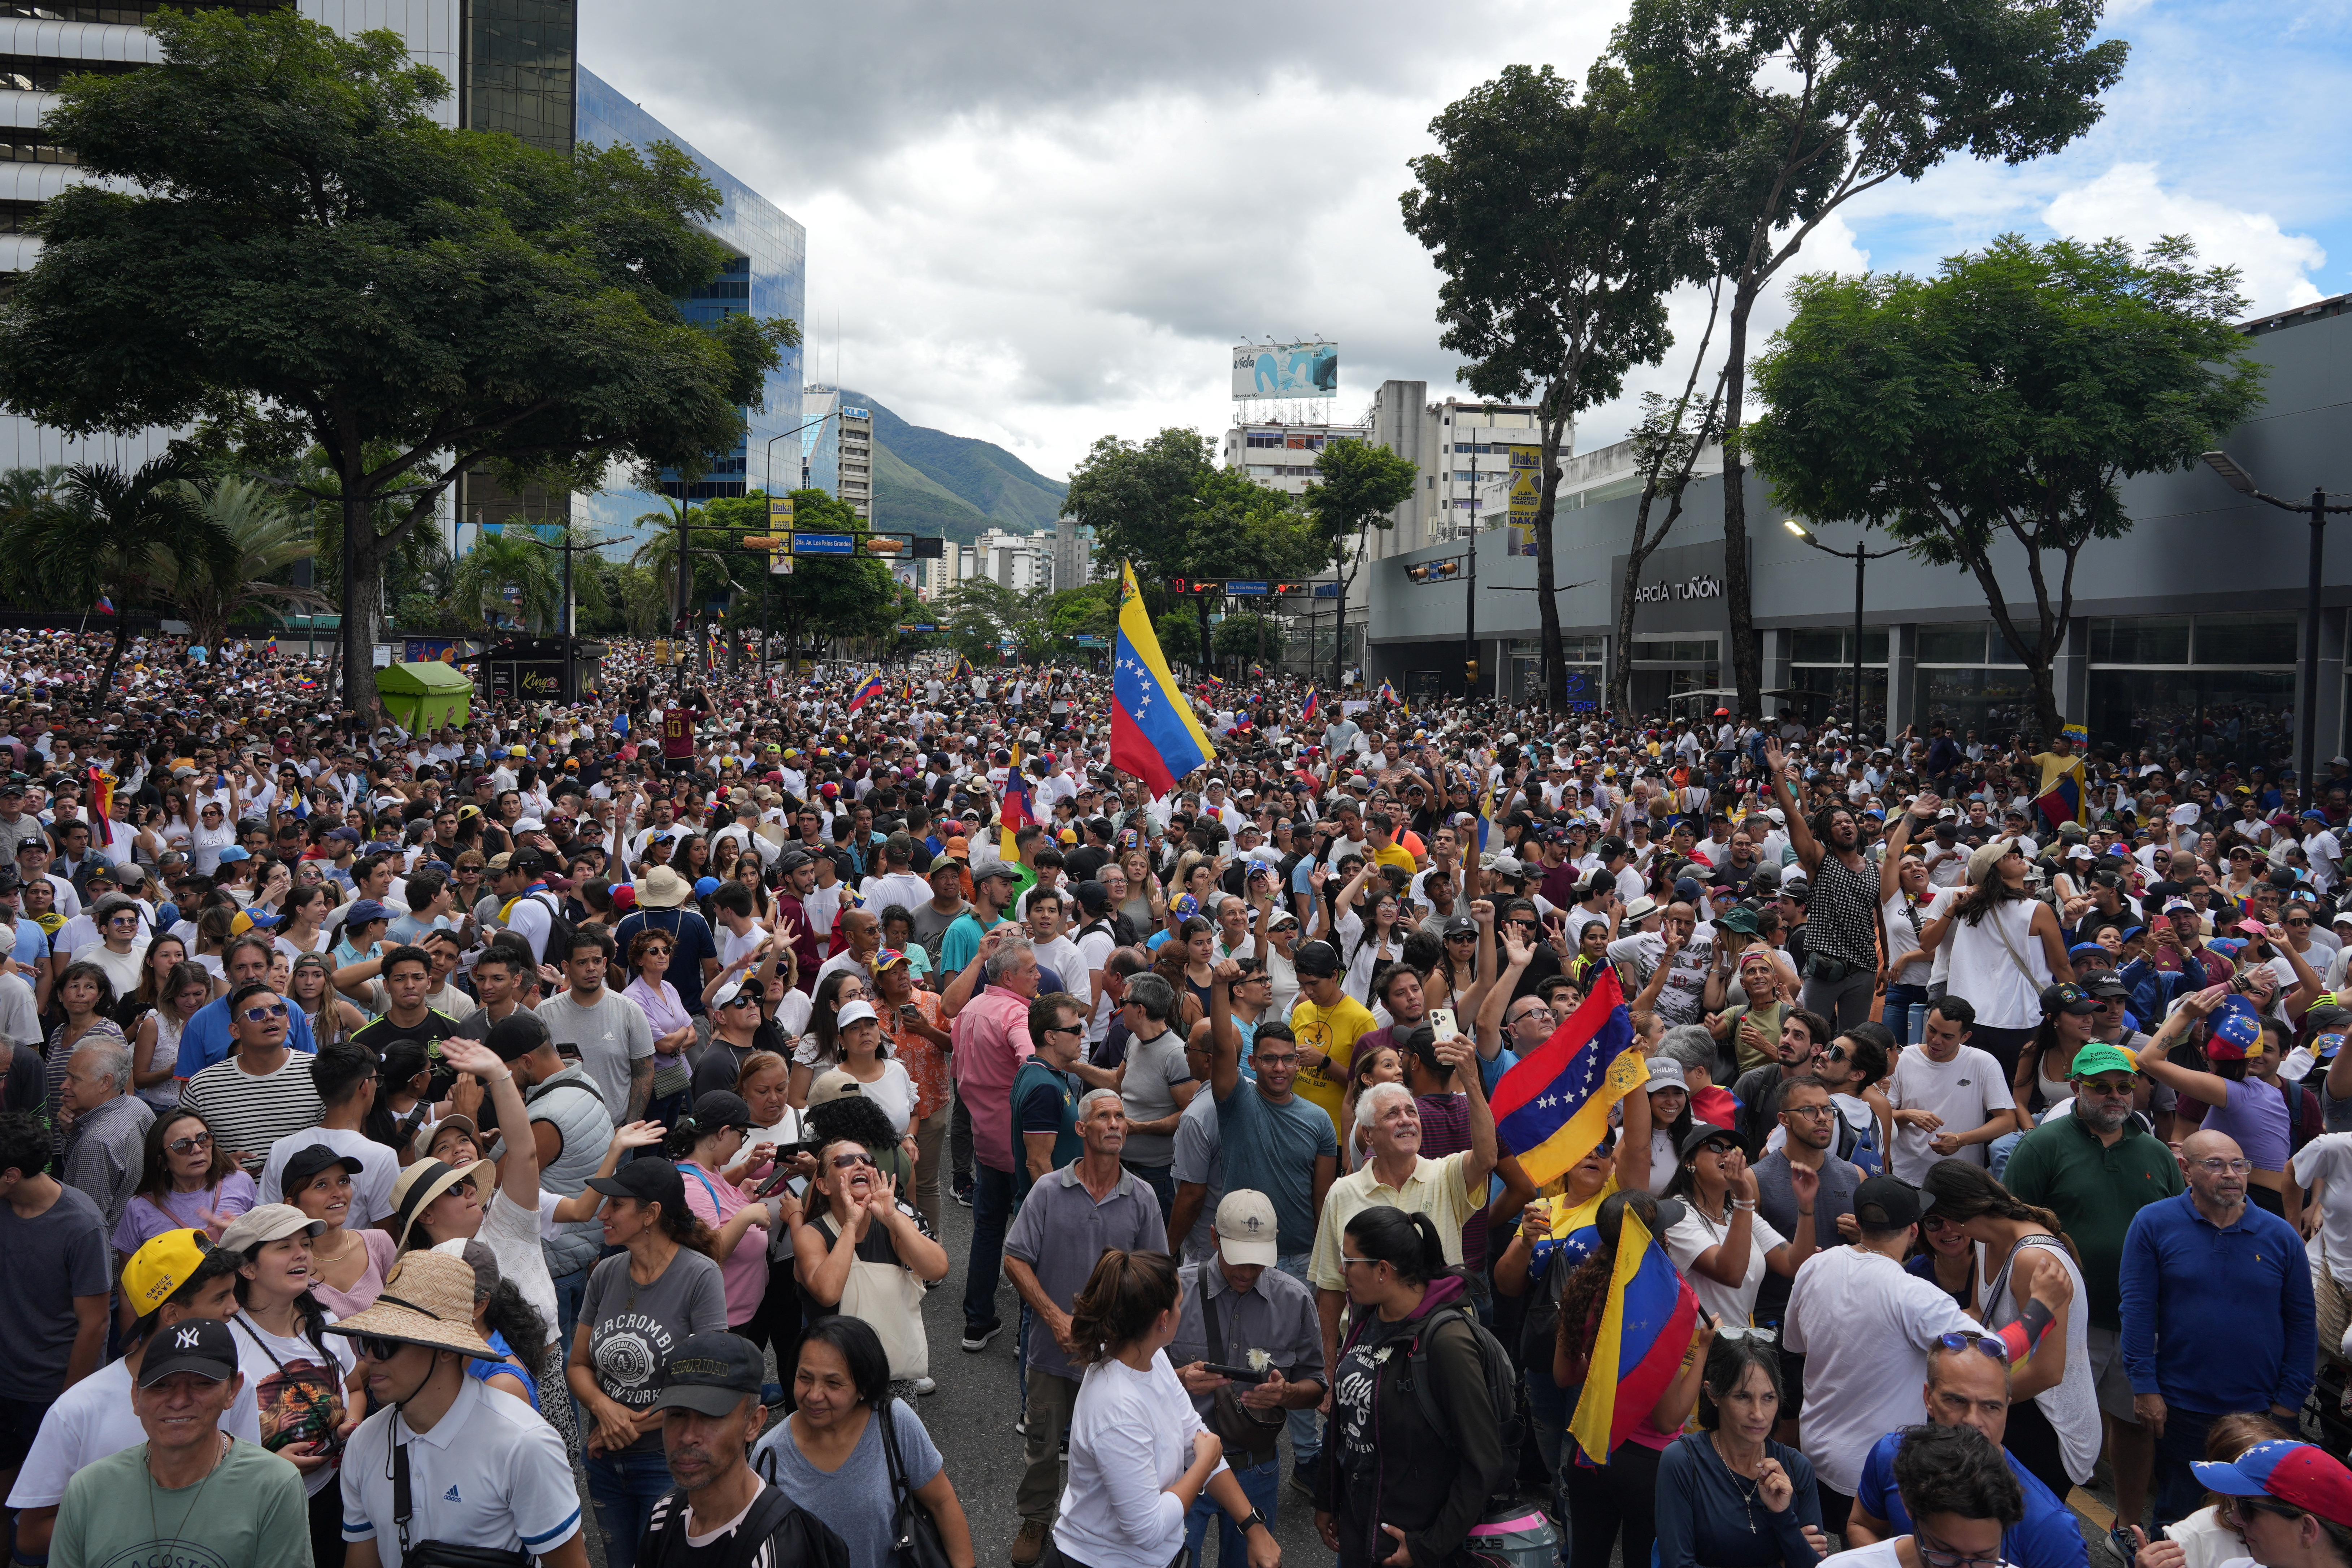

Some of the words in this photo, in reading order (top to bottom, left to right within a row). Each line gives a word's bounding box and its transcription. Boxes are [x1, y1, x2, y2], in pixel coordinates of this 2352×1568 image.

[1234, 354, 1255, 369] vida
[1512, 451, 1539, 465] Daka
[773, 503, 792, 512] Daka
[1635, 581, 1669, 602] ARCÍA
[1674, 576, 1720, 599] TUÑÓN
[521, 670, 548, 693] King
[667, 720, 682, 738] 10
[200, 837, 227, 846] LOVE
[1673, 974, 1687, 987] 10
[1305, 1068, 1320, 1078] NICE
[1652, 1067, 1678, 1075] PHILIPS
[1870, 1163, 1883, 1174] EVERLAST
[174, 1326, 200, 1349] NY
[602, 1341, 629, 1365] ABERCROMBIE
[628, 1342, 637, 1353] AND
[636, 1352, 645, 1368] FITCH
[671, 1358, 729, 1377] SEGURIDAD
[603, 1377, 626, 1400] NEW
[626, 1387, 662, 1404] YORK
[443, 1495, 462, 1503] adidas
[1465, 1538, 1505, 1550] EDGE
